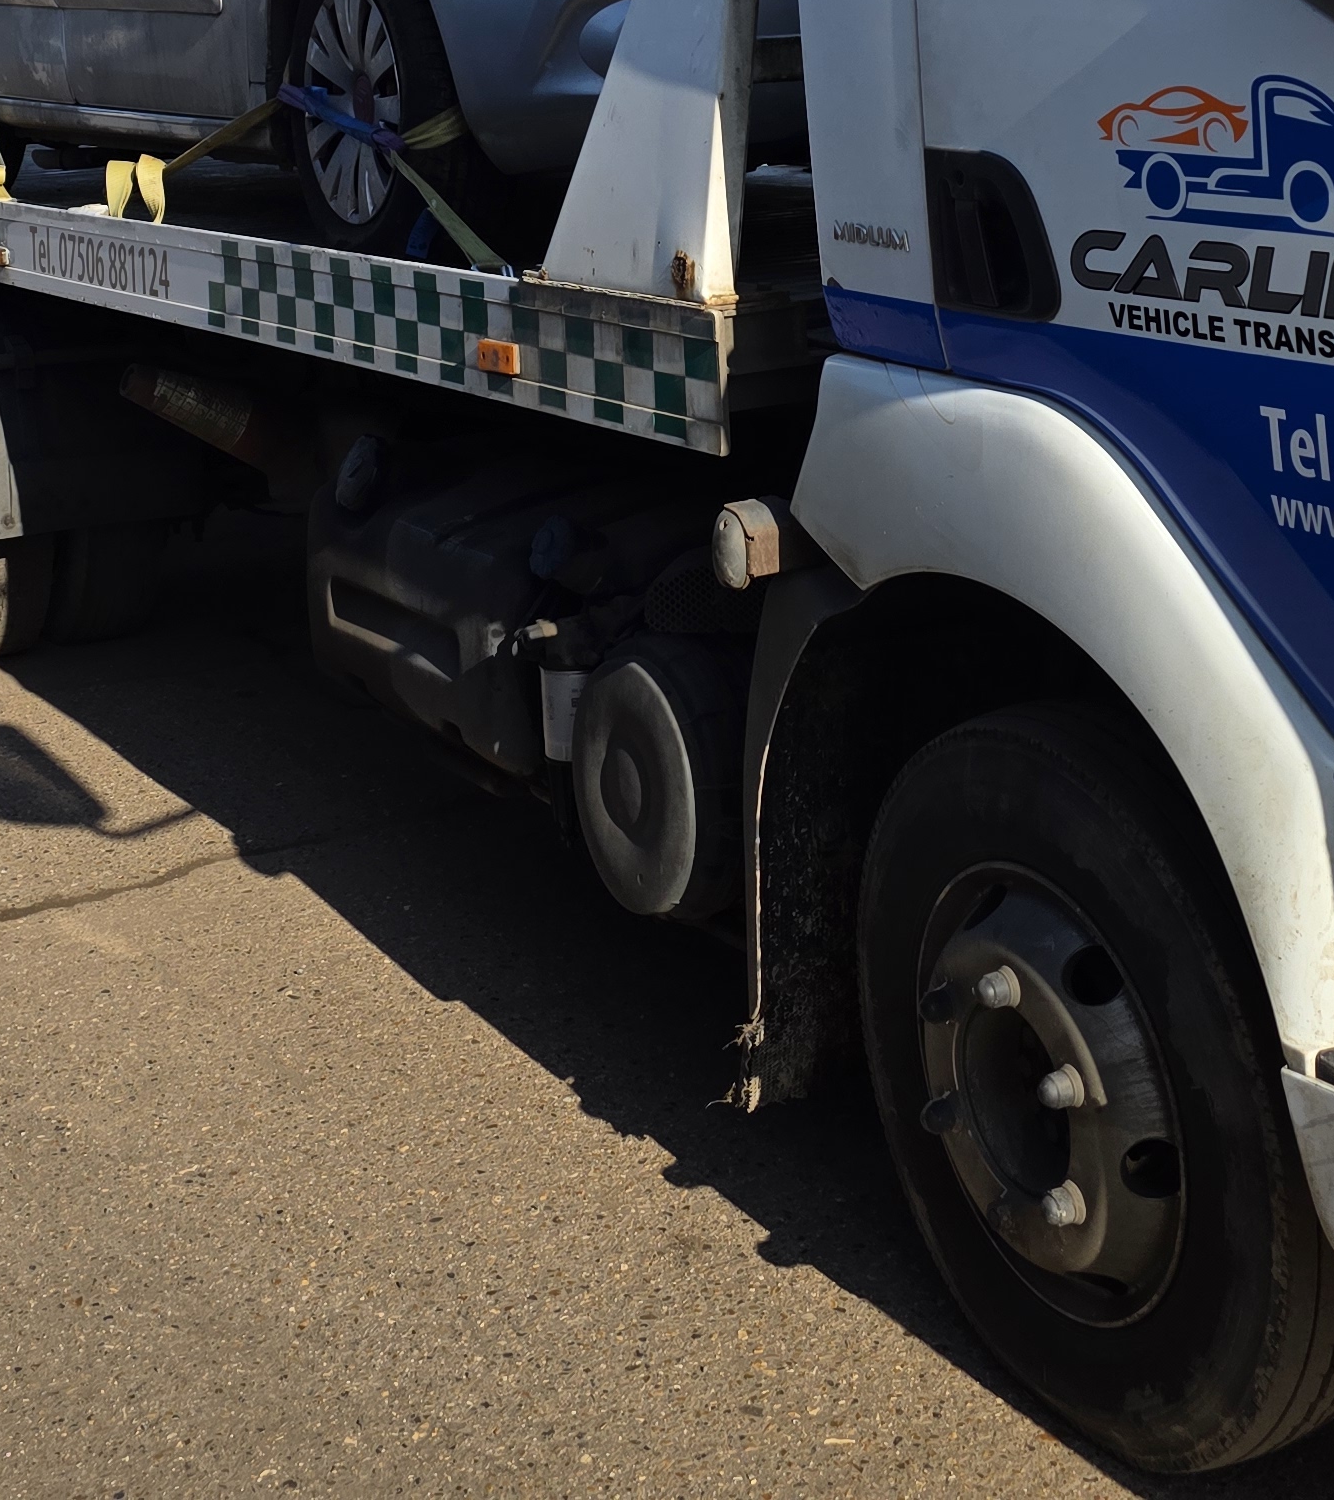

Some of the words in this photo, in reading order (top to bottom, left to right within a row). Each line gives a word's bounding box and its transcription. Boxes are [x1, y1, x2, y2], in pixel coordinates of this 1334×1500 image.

[833, 219, 910, 253] MIDLUM
[29, 226, 56, 275] Tel.
[58, 232, 105, 287] 07506
[108, 241, 170, 299] 881124
[1108, 301, 1226, 343] VEHICLE
